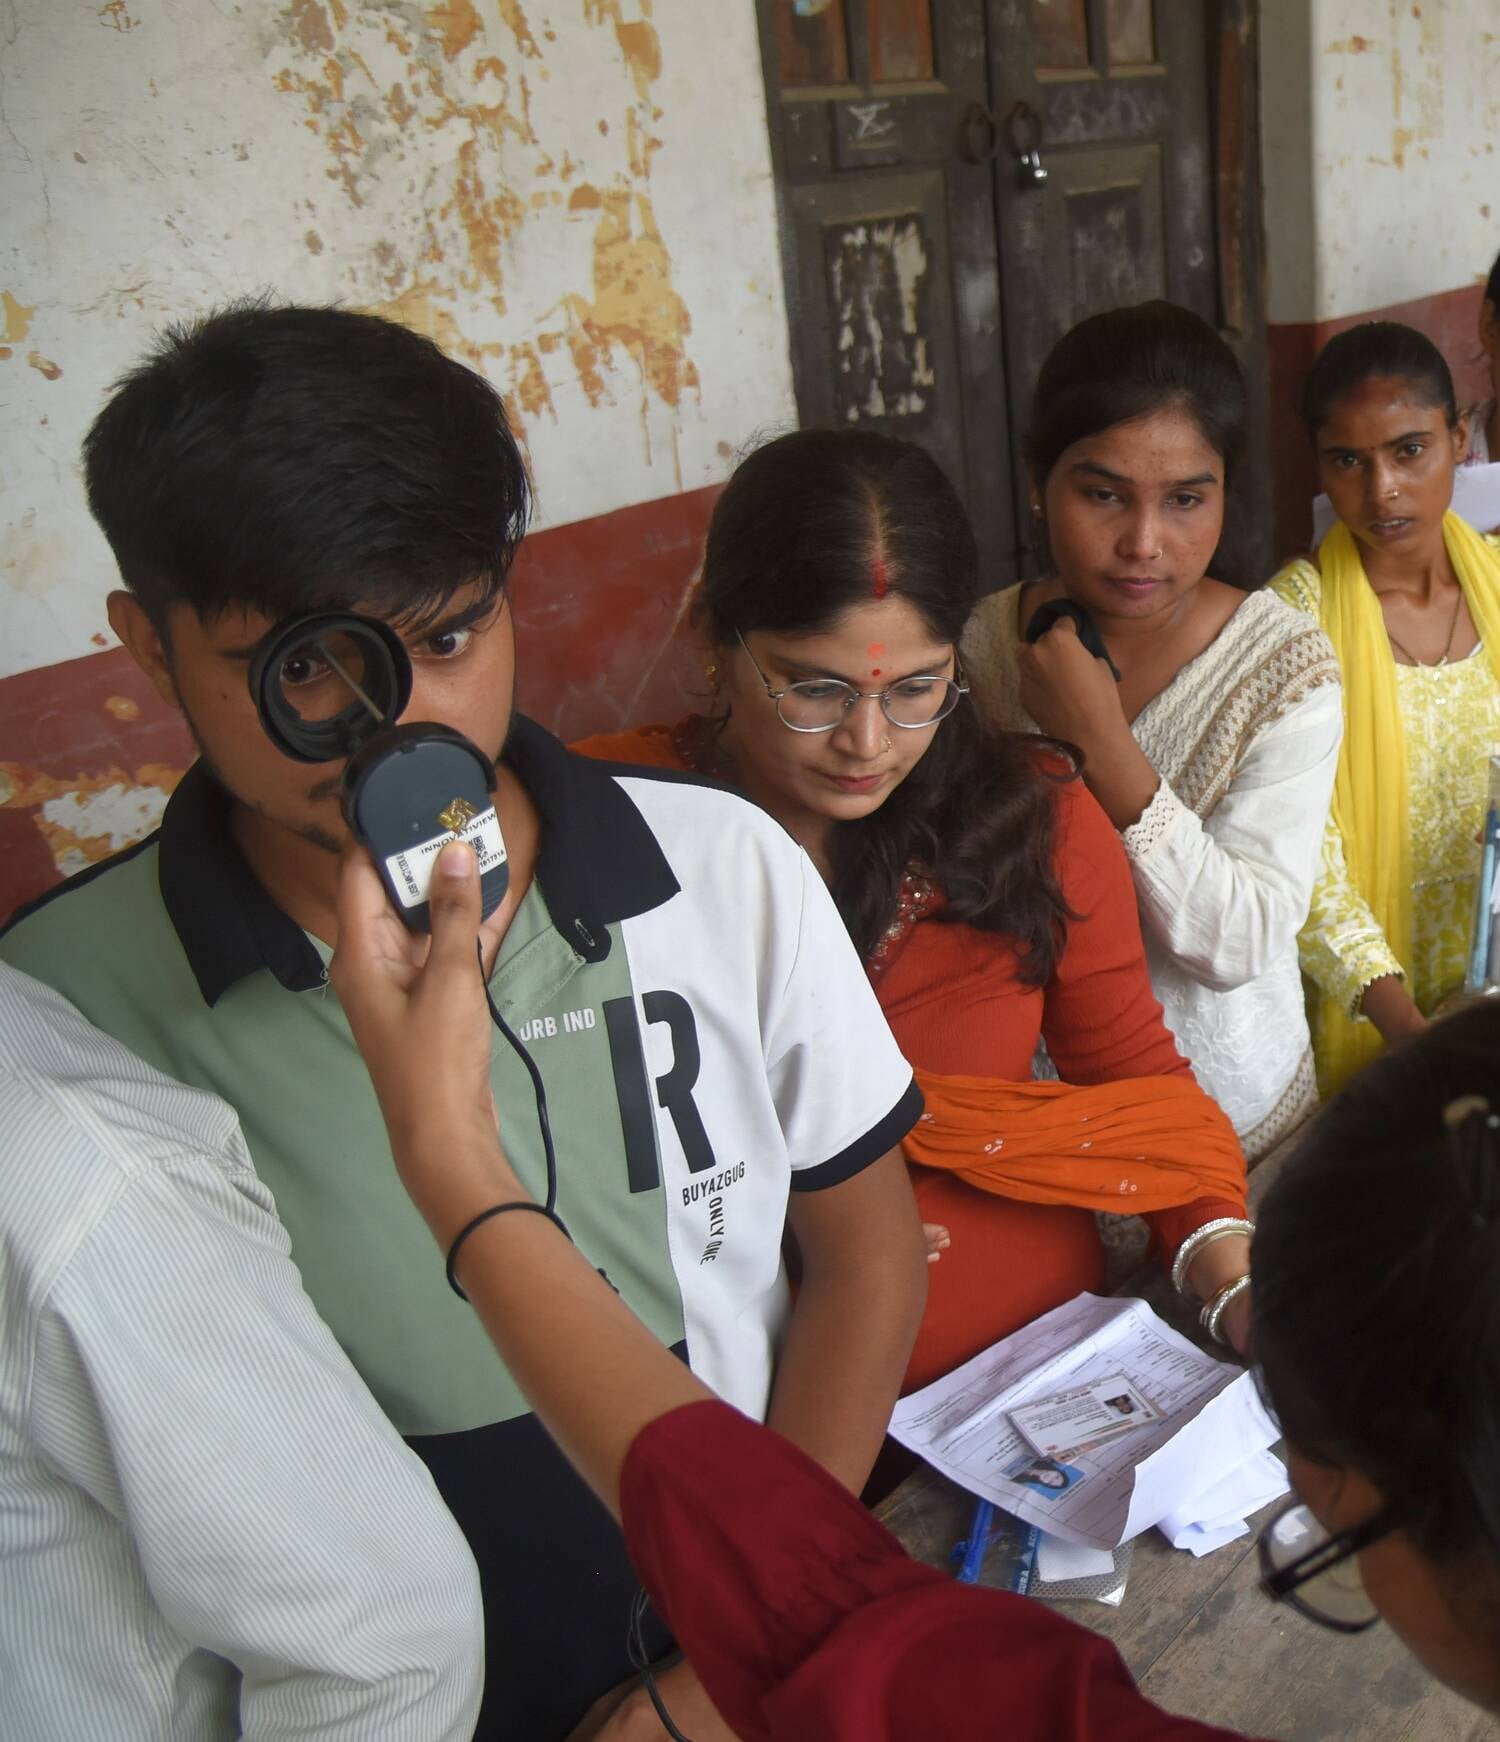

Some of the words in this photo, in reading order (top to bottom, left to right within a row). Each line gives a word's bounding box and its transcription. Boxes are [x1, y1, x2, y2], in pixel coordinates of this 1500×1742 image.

[562, 1008, 596, 1033] IND
[602, 990, 716, 1194] R
[682, 1161, 745, 1206] BUYAZGUG
[709, 1196, 725, 1238] ONLY
[700, 1240, 723, 1265] ONE
